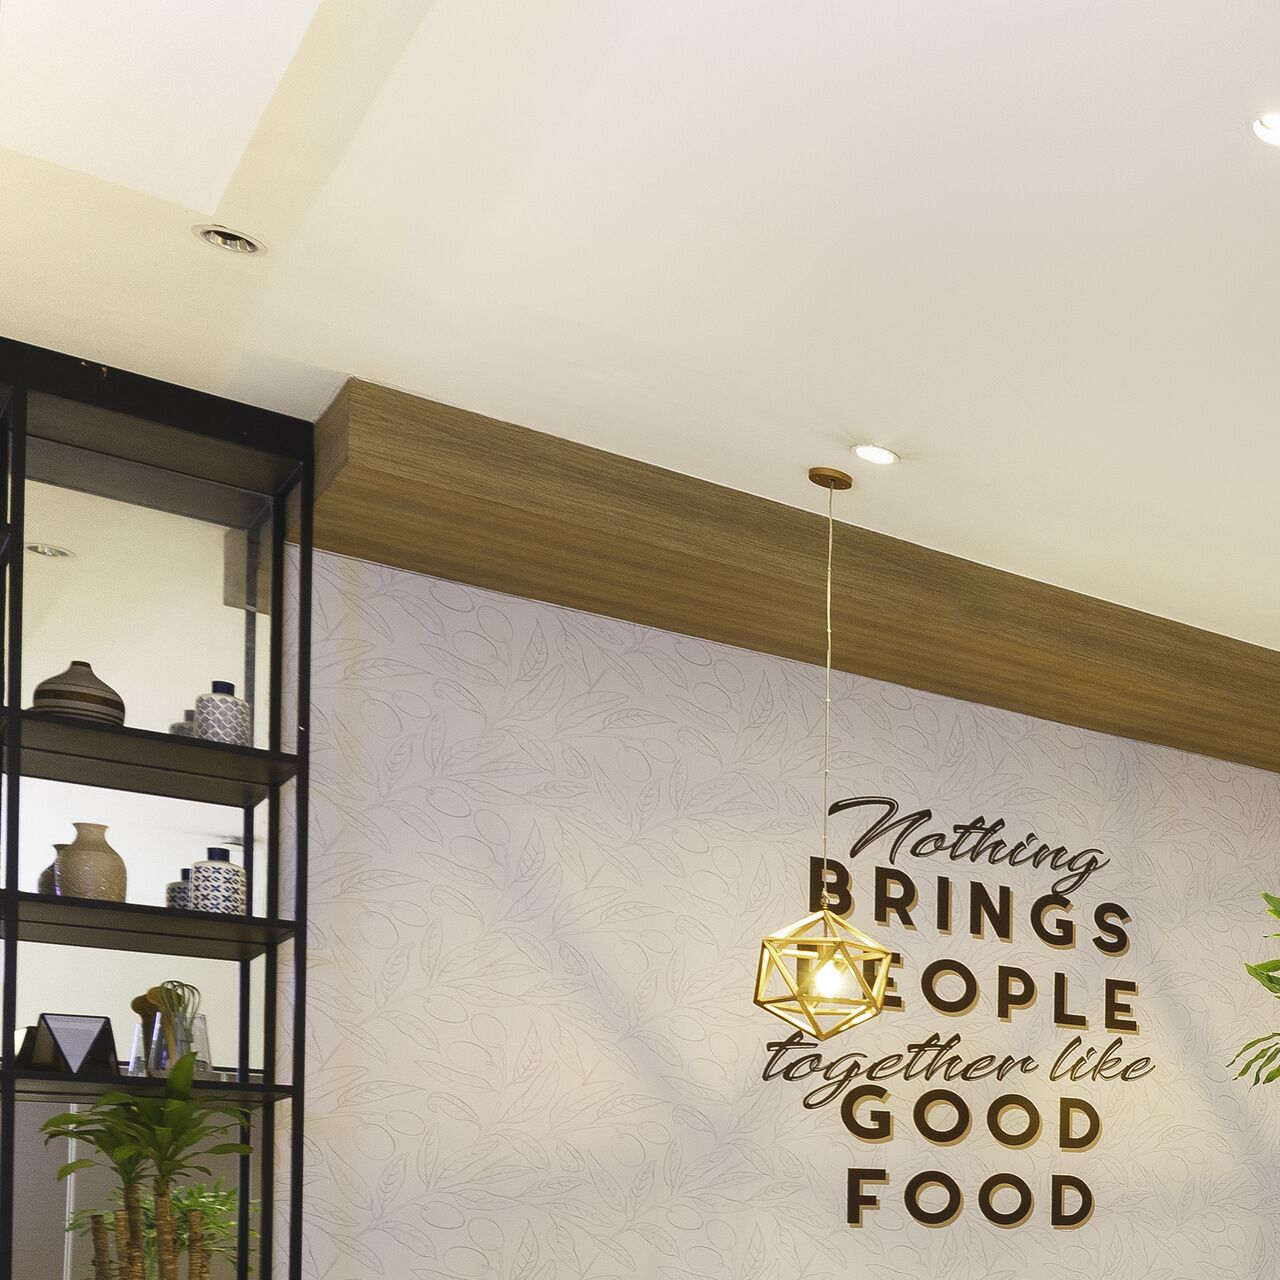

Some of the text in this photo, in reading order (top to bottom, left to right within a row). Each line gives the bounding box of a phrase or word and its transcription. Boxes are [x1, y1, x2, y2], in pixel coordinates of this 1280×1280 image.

[828, 795, 1111, 895] Nothing
[808, 855, 1132, 955] BRINGS
[762, 1031, 1156, 1110] together like
[840, 1084, 1101, 1152] GOOD
[847, 1166, 1095, 1231] FOOD
